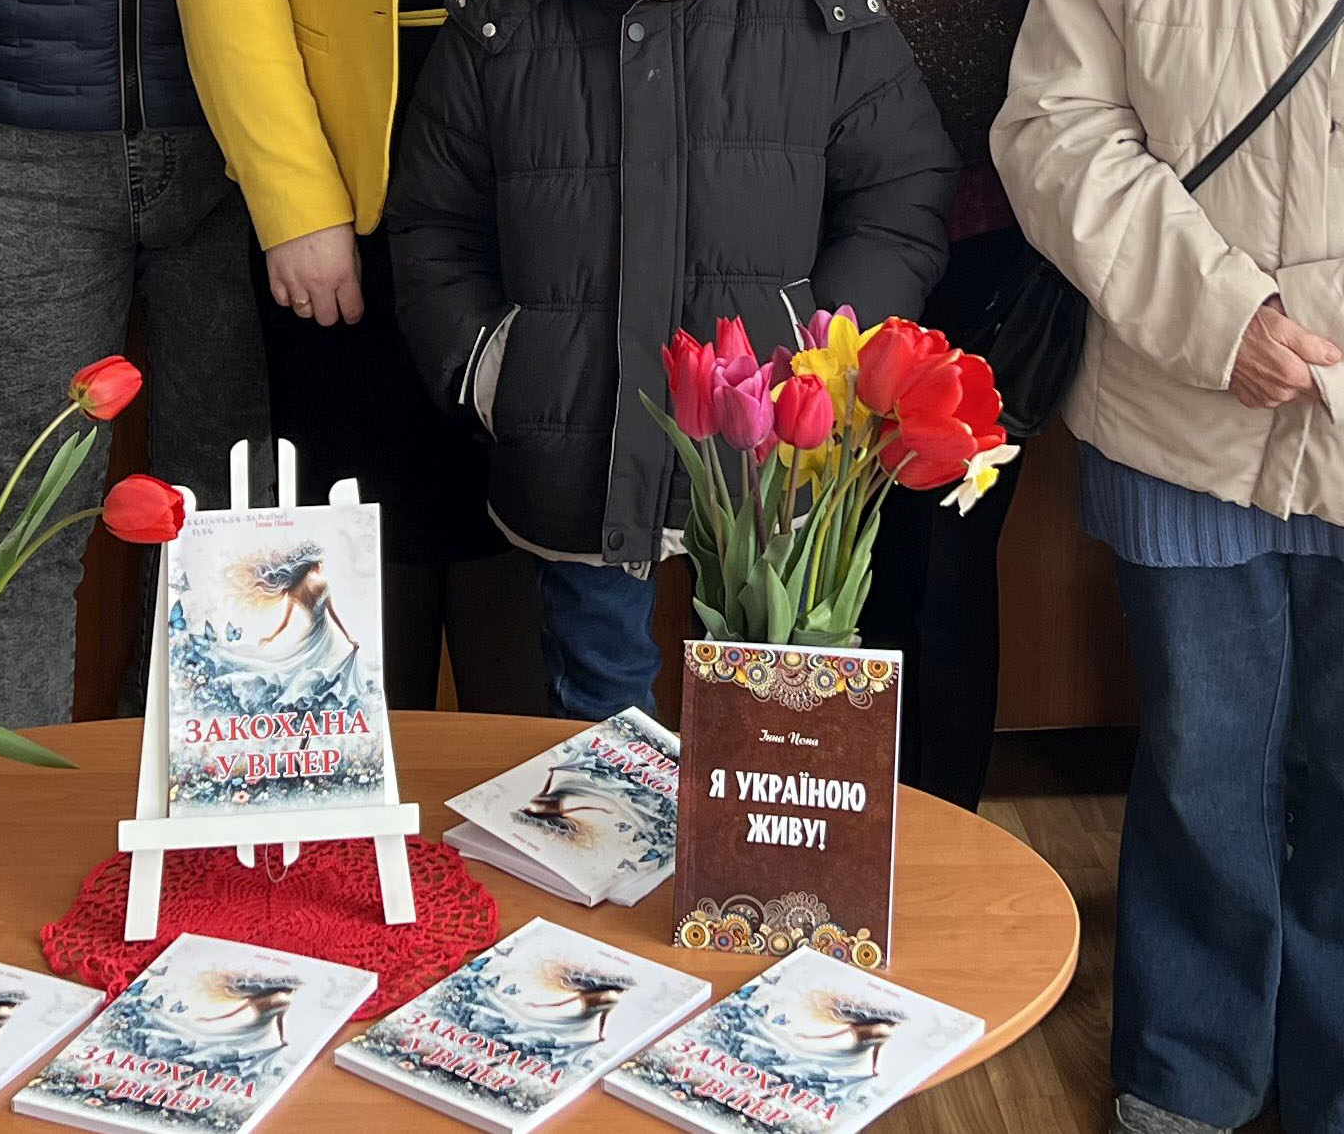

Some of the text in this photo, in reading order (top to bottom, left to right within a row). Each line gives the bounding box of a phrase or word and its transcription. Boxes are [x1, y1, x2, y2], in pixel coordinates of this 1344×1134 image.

[185, 709, 370, 746] ЗАКОХАНА
[758, 729, 786, 745] Інна
[217, 749, 341, 781] У ВІТЕР
[589, 734, 679, 802] ОХАНА
[626, 740, 679, 779] ТЕР
[708, 768, 867, 813] Я УКРАЇНОЮ
[746, 812, 828, 851] ЖИВУ!
[401, 1009, 568, 1086] ЗАКОХАНА
[403, 1036, 518, 1093] У ВІТЕР
[73, 1044, 257, 1100] ЗАКОХАНА
[87, 1070, 213, 1115] У ВІТЕР
[668, 1037, 839, 1124] ЗАКОХАНА
[677, 1063, 792, 1126] У ВІТЕР
